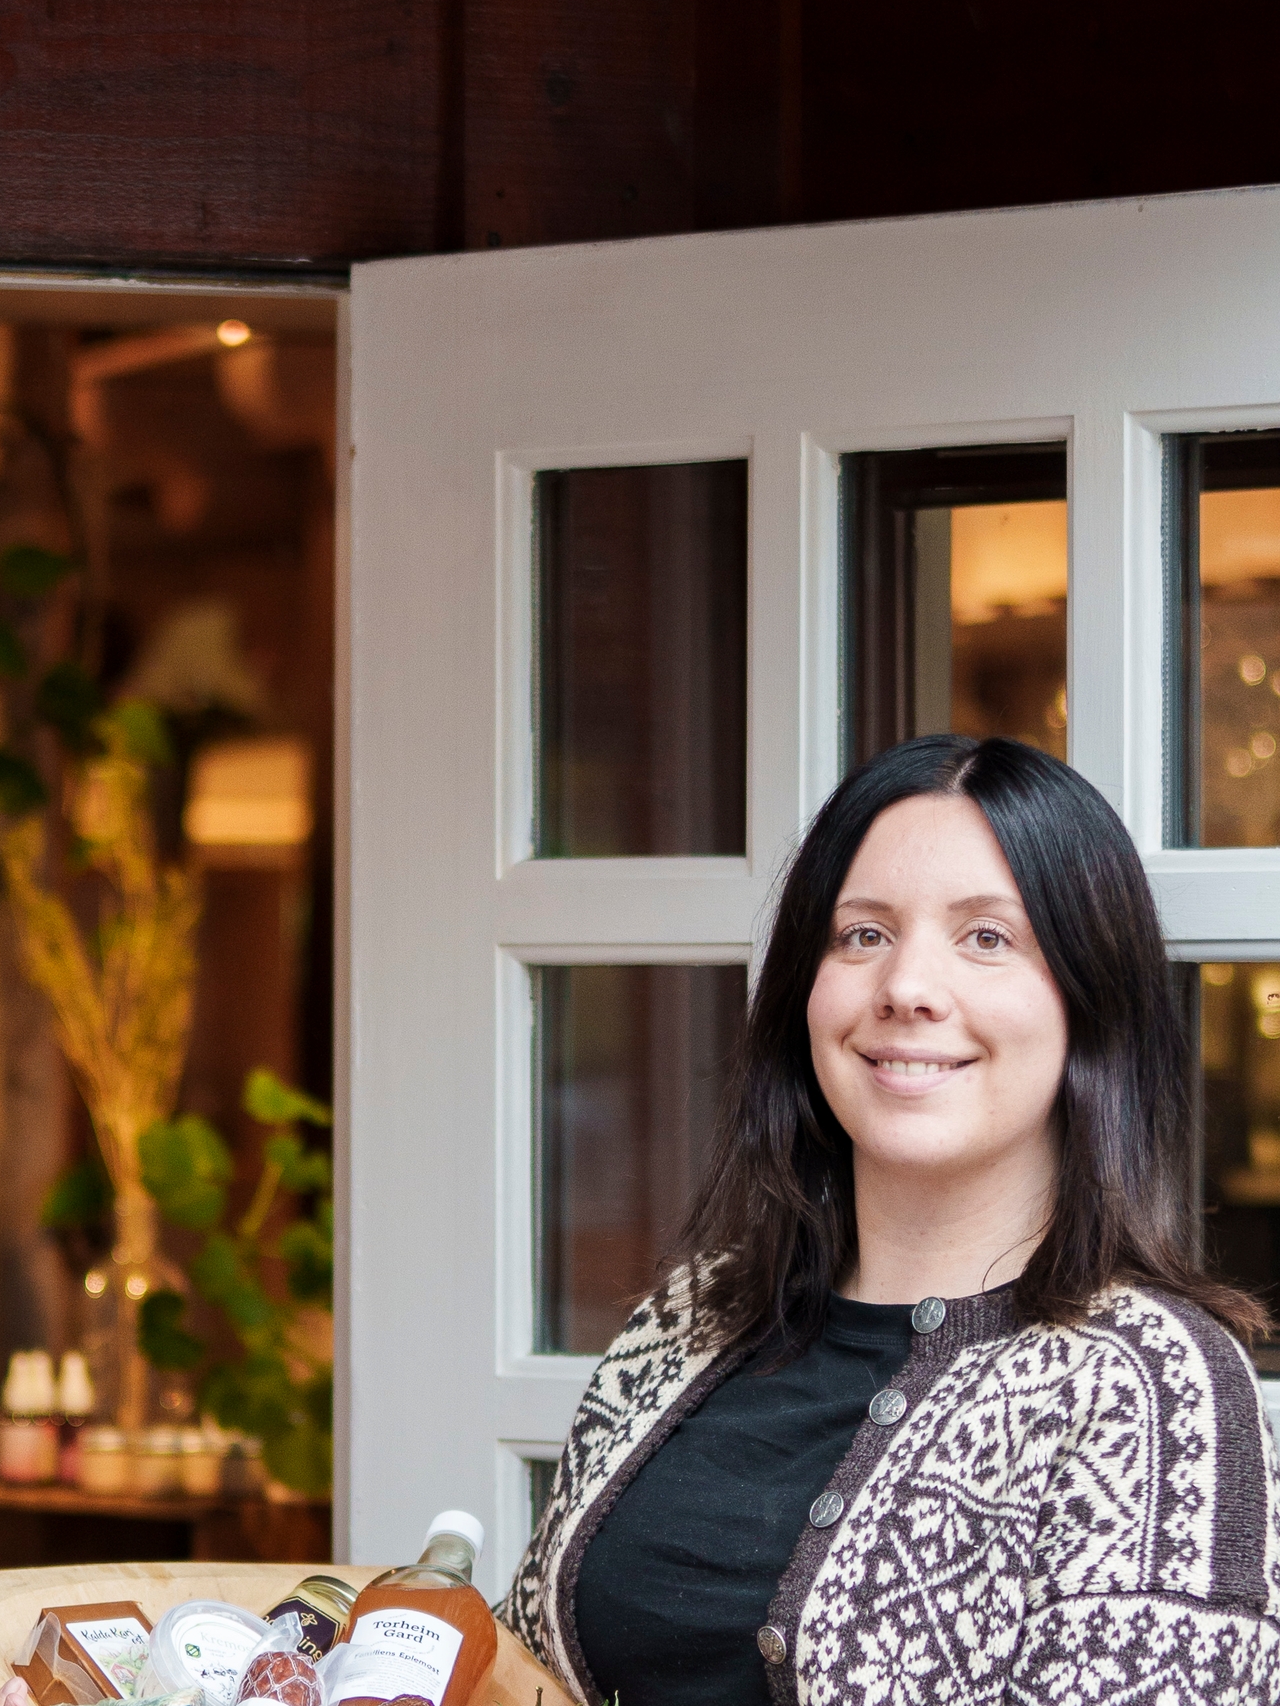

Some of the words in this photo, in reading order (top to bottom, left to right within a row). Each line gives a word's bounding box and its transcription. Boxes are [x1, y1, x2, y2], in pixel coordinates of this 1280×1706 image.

[373, 1620, 440, 1641] Torheim
[383, 1629, 424, 1643] Gard
[398, 1651, 440, 1675] Eplemost
